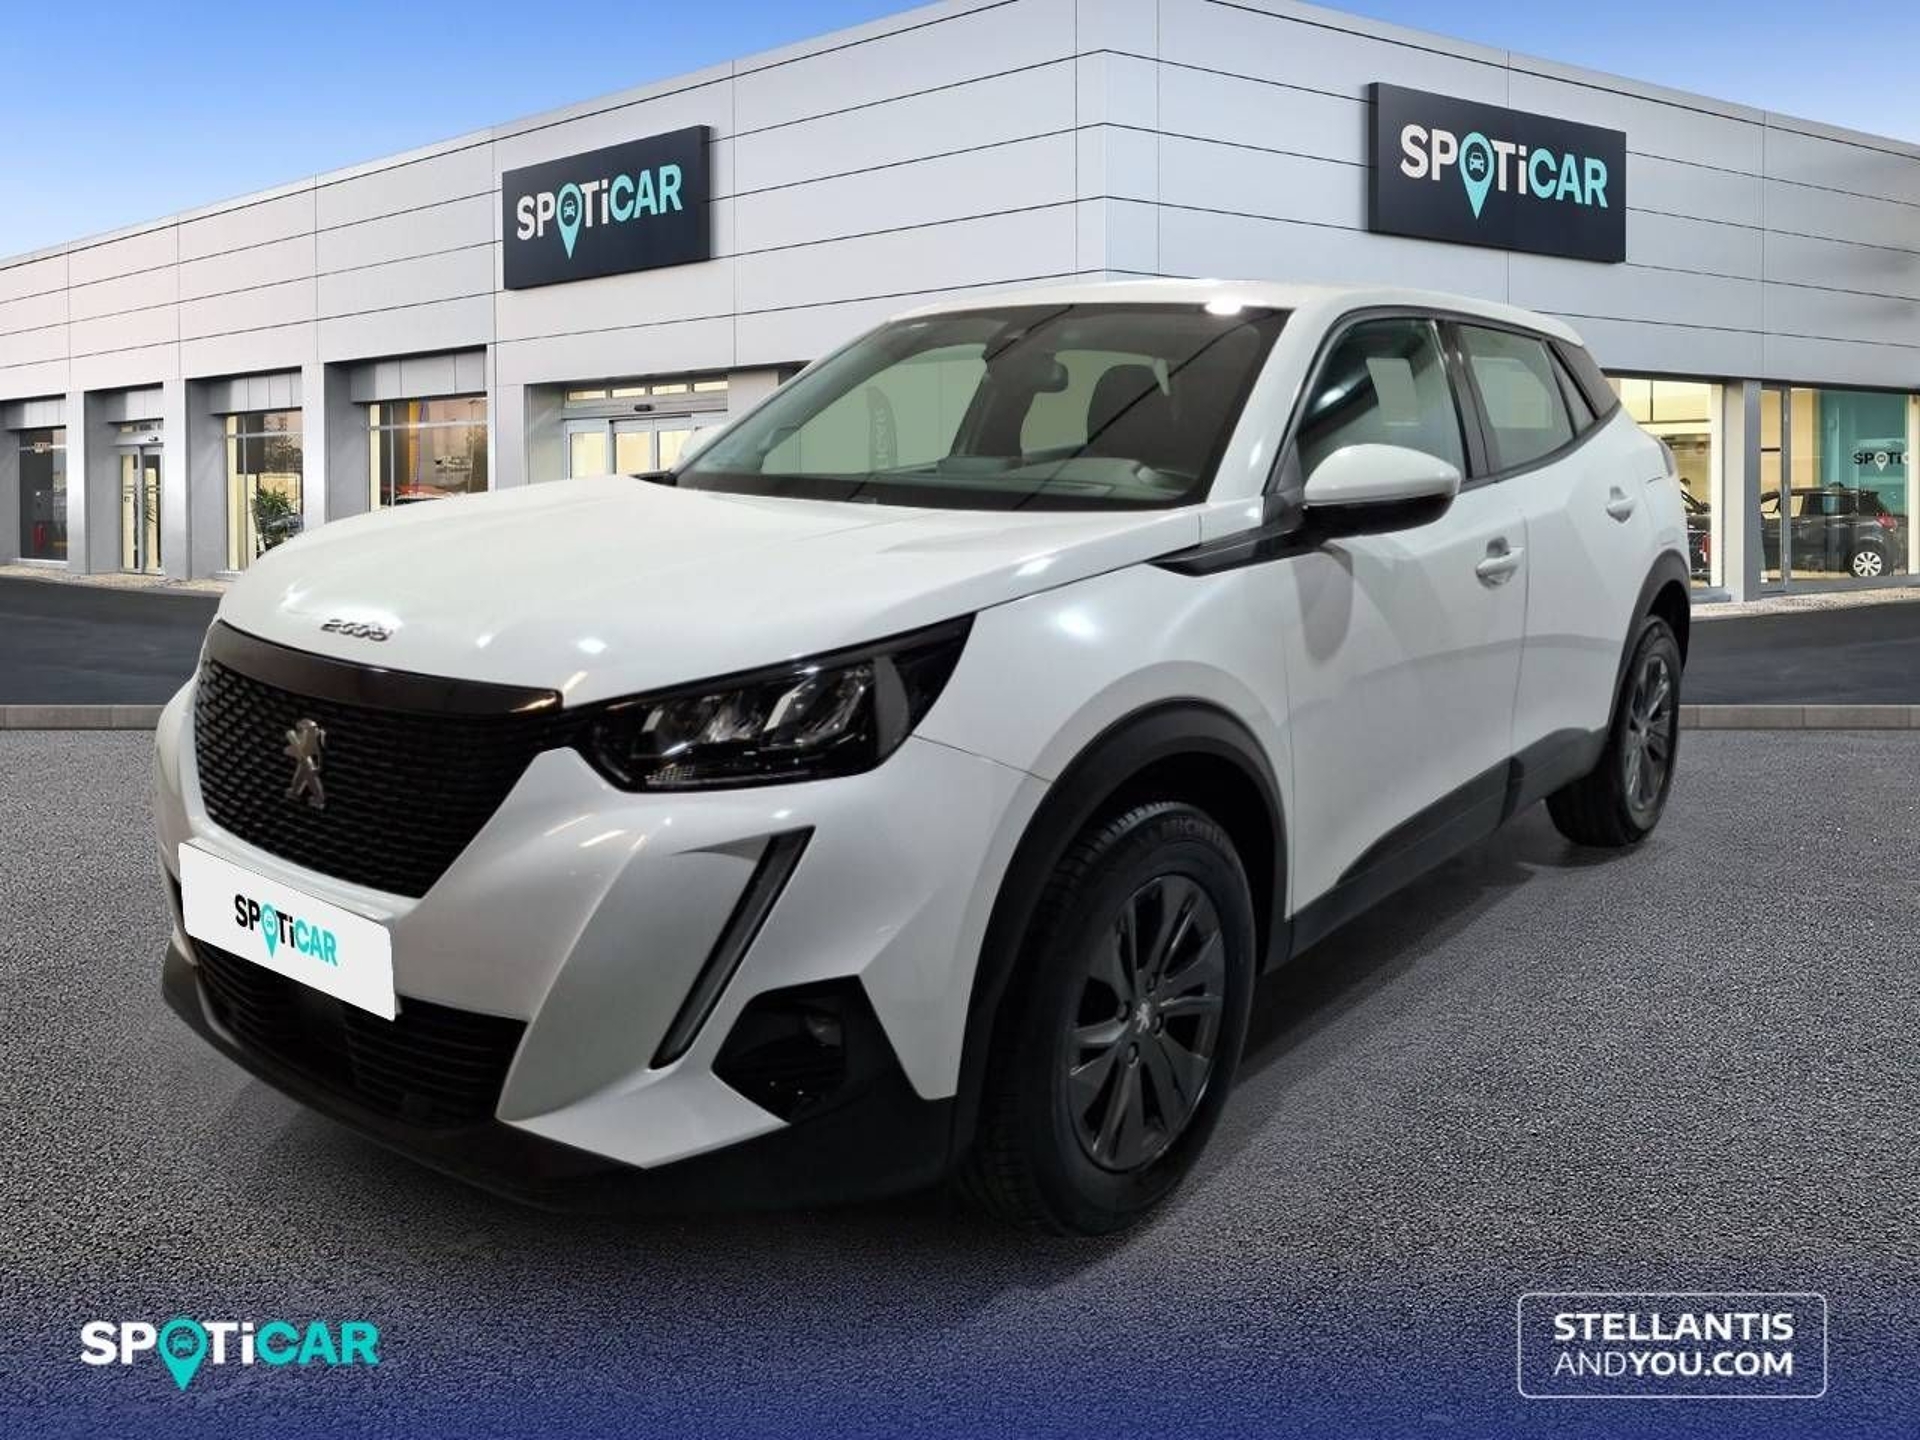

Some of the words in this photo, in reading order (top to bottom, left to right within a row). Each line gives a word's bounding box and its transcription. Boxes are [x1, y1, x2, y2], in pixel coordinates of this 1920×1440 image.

[516, 164, 684, 260] SPOTiCAR
[1400, 123, 1609, 219] SPOTiCAR
[234, 893, 338, 966] SPOTiCAR
